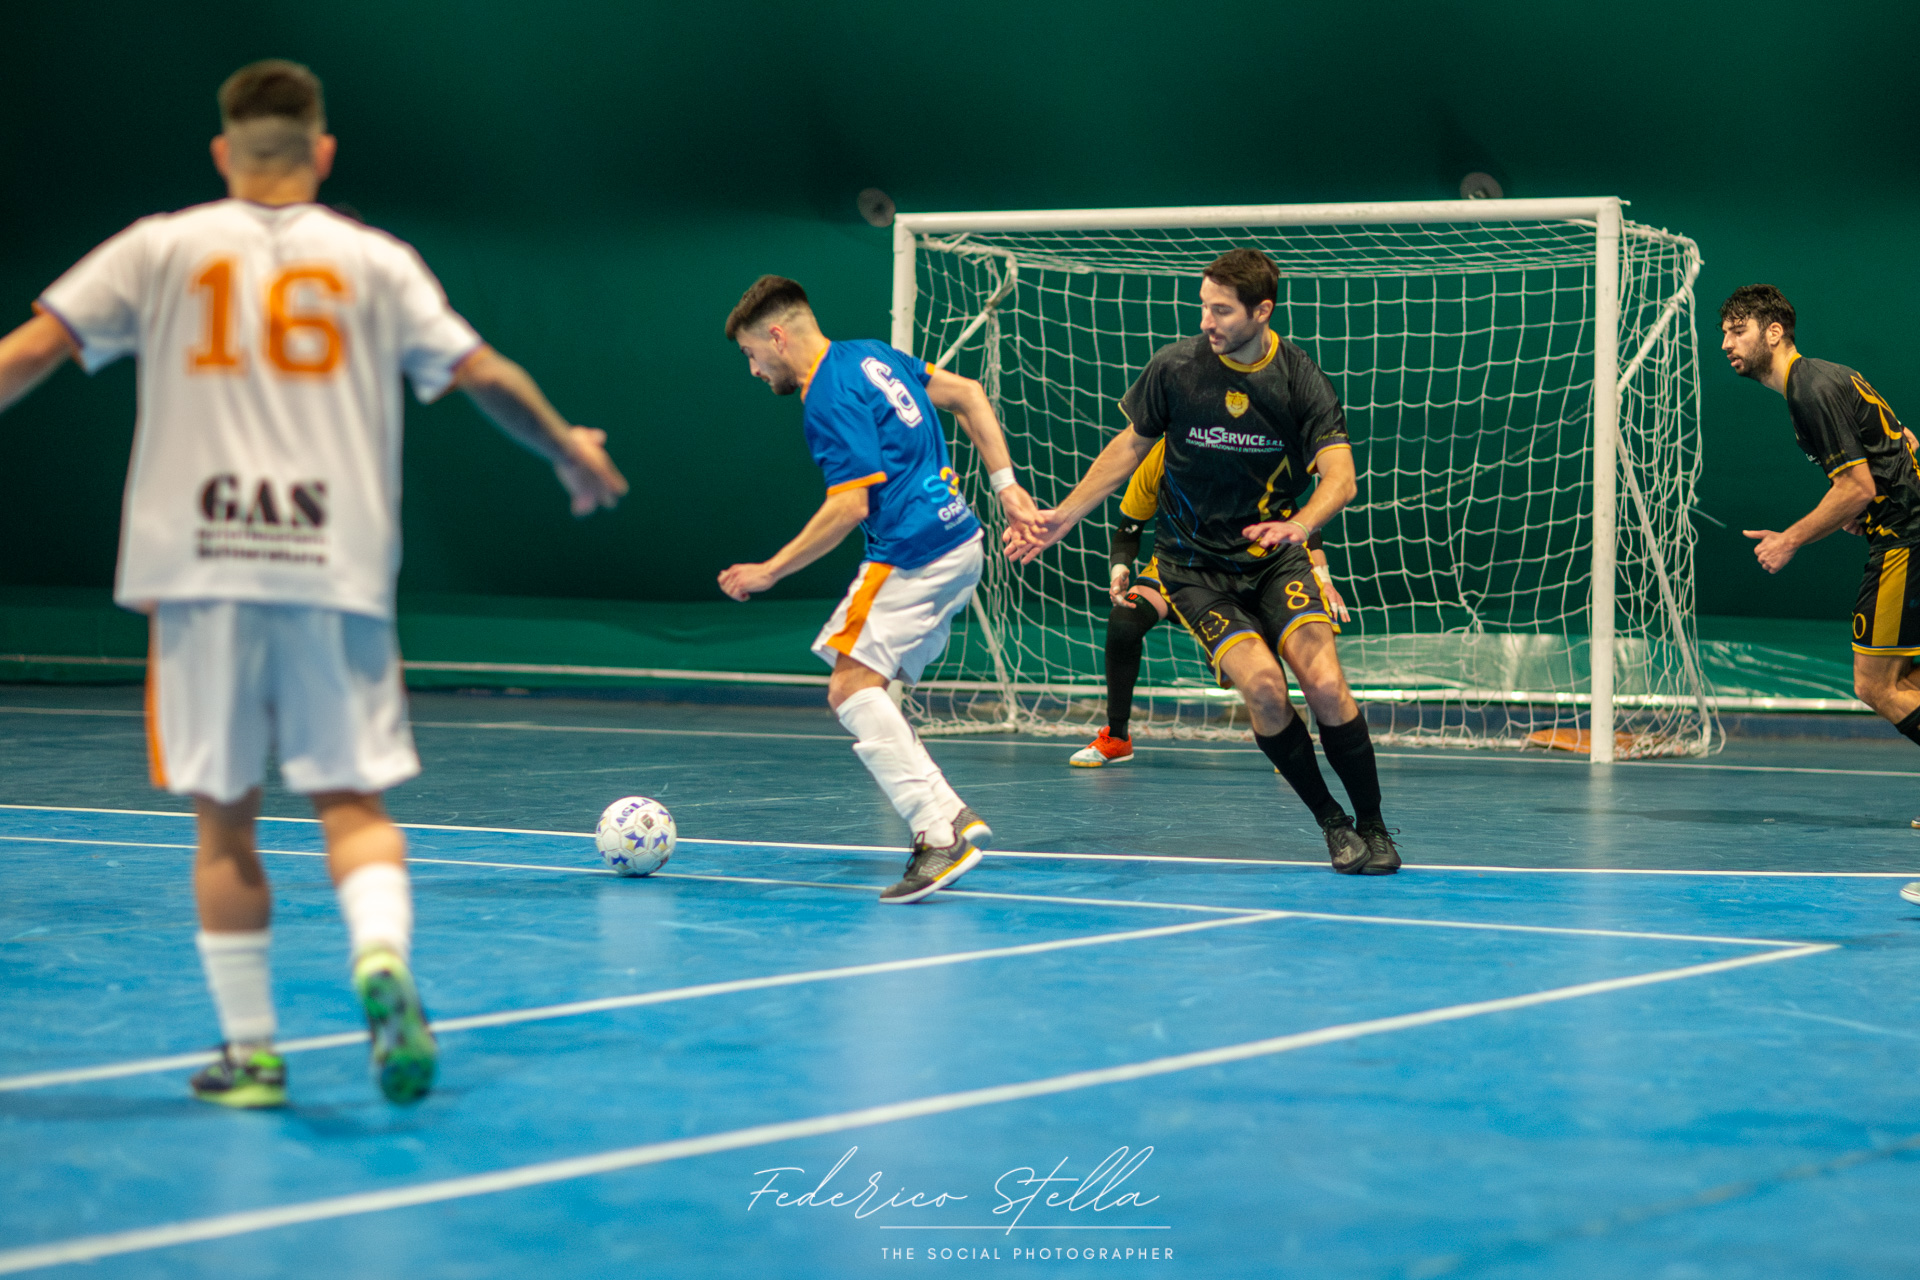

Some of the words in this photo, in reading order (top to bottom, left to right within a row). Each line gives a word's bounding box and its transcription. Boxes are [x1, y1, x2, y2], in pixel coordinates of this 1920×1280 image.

[188, 254, 352, 382] 16
[861, 356, 923, 428] 6
[200, 473, 327, 528] GAS
[1285, 580, 1310, 610] 8
